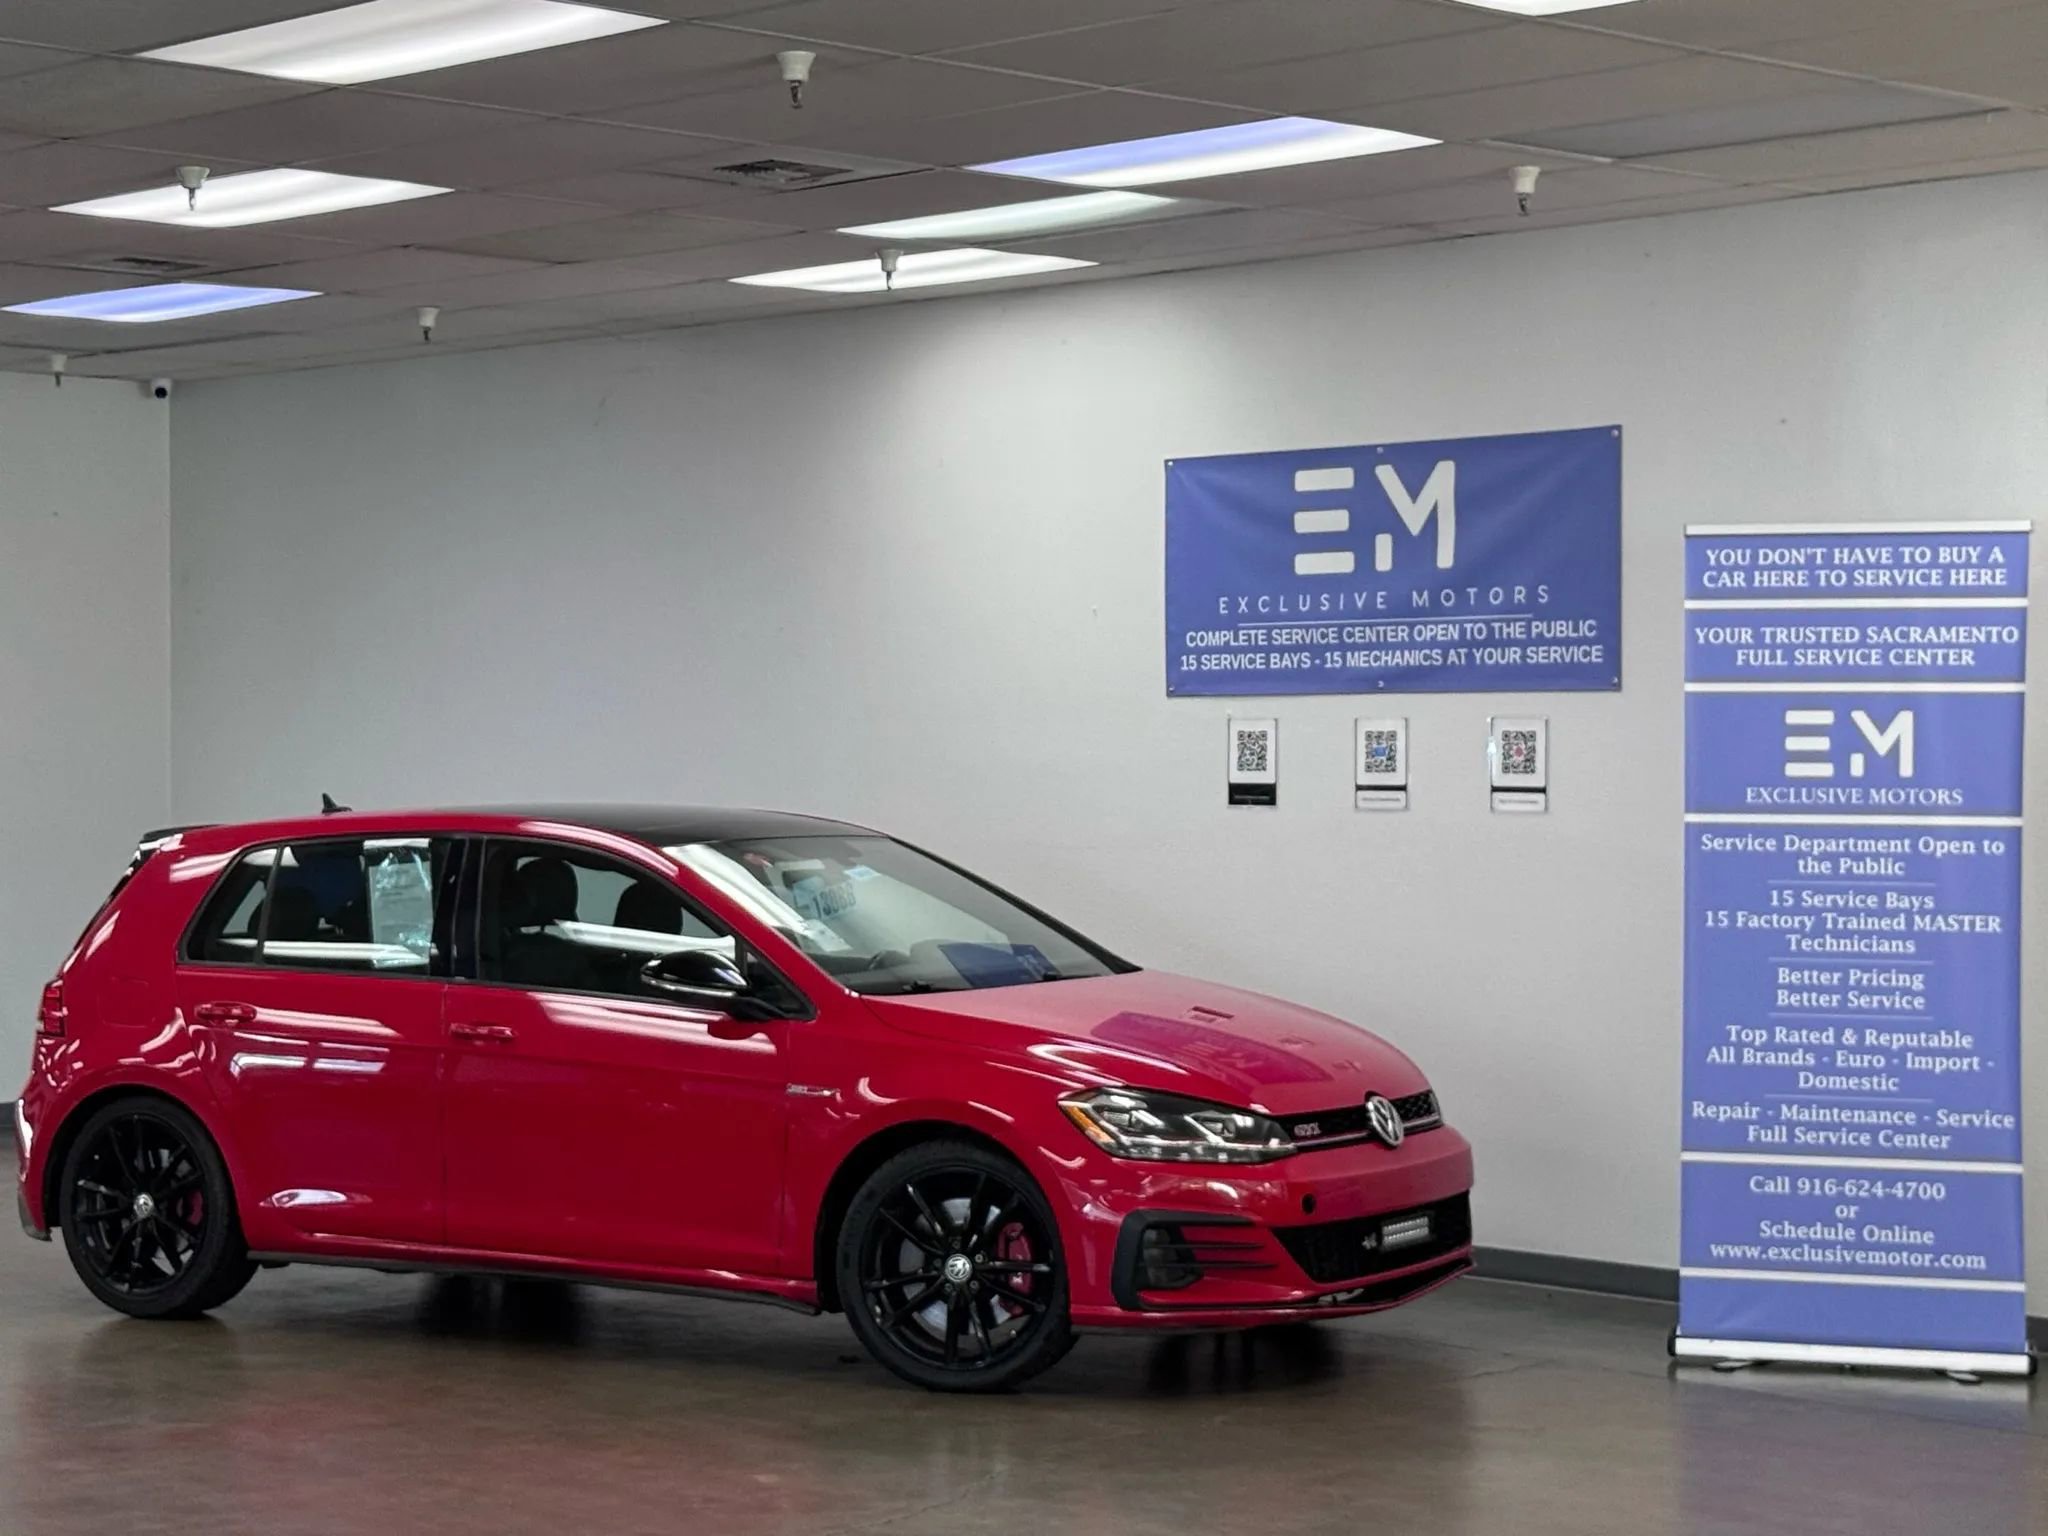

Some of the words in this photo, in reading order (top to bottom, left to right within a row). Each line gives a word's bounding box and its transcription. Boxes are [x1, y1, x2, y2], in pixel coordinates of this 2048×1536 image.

[1706, 550, 1751, 566] YOU
[1759, 549, 1827, 565] DON'T
[1834, 548, 1892, 564] HAVE
[1899, 547, 1931, 563] TO
[1939, 547, 1982, 563] BUY
[1988, 546, 2004, 563] A
[1703, 571, 1746, 587] CAR
[1754, 571, 1808, 586] HERE
[1816, 571, 1847, 586] TO
[1854, 569, 1942, 586] SERVICE
[1950, 569, 2007, 585] HERE
[1219, 591, 1387, 614] EXCLUSIVE
[1413, 585, 1550, 608] MOTORS
[1186, 629, 1268, 647] COMPLETE
[1272, 627, 1340, 645] SERVICE
[1343, 626, 1410, 643] CENTER
[1414, 624, 1459, 640] OPEN
[1463, 623, 1487, 639] TO
[1491, 622, 1527, 639] THE
[1531, 620, 1597, 638] PUBLIC
[1695, 628, 1754, 644] YOUR
[1760, 627, 1859, 643] TRUSTED
[1867, 626, 2019, 643] SACRAMENTO
[1181, 655, 1197, 670] 15
[1200, 653, 1267, 670] SERVICE
[1270, 652, 1311, 668] BAYS
[1325, 652, 1343, 667] 15
[1346, 650, 1442, 667] MECHANICS
[1447, 649, 1469, 664] AT
[1472, 647, 1521, 664] YOUR
[1526, 645, 1603, 663] SERVICE
[1736, 650, 1787, 666] FULL
[1794, 650, 1882, 665] SERVICE
[1889, 650, 1975, 665] CENTER
[1746, 787, 1862, 804] EXCLUSIVE
[1869, 789, 1963, 805] MOTORS
[1701, 834, 1777, 851] Service
[1784, 835, 1910, 855] Department
[1918, 837, 1975, 857] Open
[1983, 839, 2005, 855] to
[1798, 859, 1832, 874] the
[1840, 858, 1905, 875] Public
[1770, 891, 1793, 907] 15
[1801, 891, 1878, 908] Service
[1886, 893, 1934, 911] Bays
[1705, 911, 1728, 927] 15
[1736, 912, 1815, 932] Factory
[1822, 913, 1905, 930] Trained
[1913, 916, 2002, 932] MASTER
[1786, 935, 1915, 954] Technicians
[1777, 968, 1841, 985] Better
[1848, 969, 1925, 990] Pricing
[1776, 990, 1841, 1007] Better
[1848, 992, 1925, 1009] Service
[1726, 1025, 1767, 1045] Top
[1774, 1026, 1834, 1044] Rated
[1842, 1029, 1857, 1044] &
[1864, 1030, 1973, 1049] Reputable
[1706, 1047, 1734, 1064] All
[1742, 1047, 1815, 1065] Brands
[1835, 1051, 1885, 1067] Euro
[1906, 1052, 1980, 1073] Import
[1798, 1072, 1899, 1090] Domestic
[1692, 1102, 1760, 1121] Repair
[1780, 1104, 1916, 1125] Maintenance
[1936, 1109, 2015, 1128] Service
[1747, 1125, 1787, 1143] Full
[1794, 1127, 1871, 1145] Service
[1879, 1130, 1950, 1149] Center
[1750, 1176, 1789, 1193] Call
[1797, 1177, 1945, 1200] 916-624-4700
[1835, 1203, 1858, 1219] or
[1759, 1221, 1855, 1242] Schedule
[1863, 1225, 1934, 1244] Online
[1710, 1242, 1987, 1269] www.exclusivemotor.com
